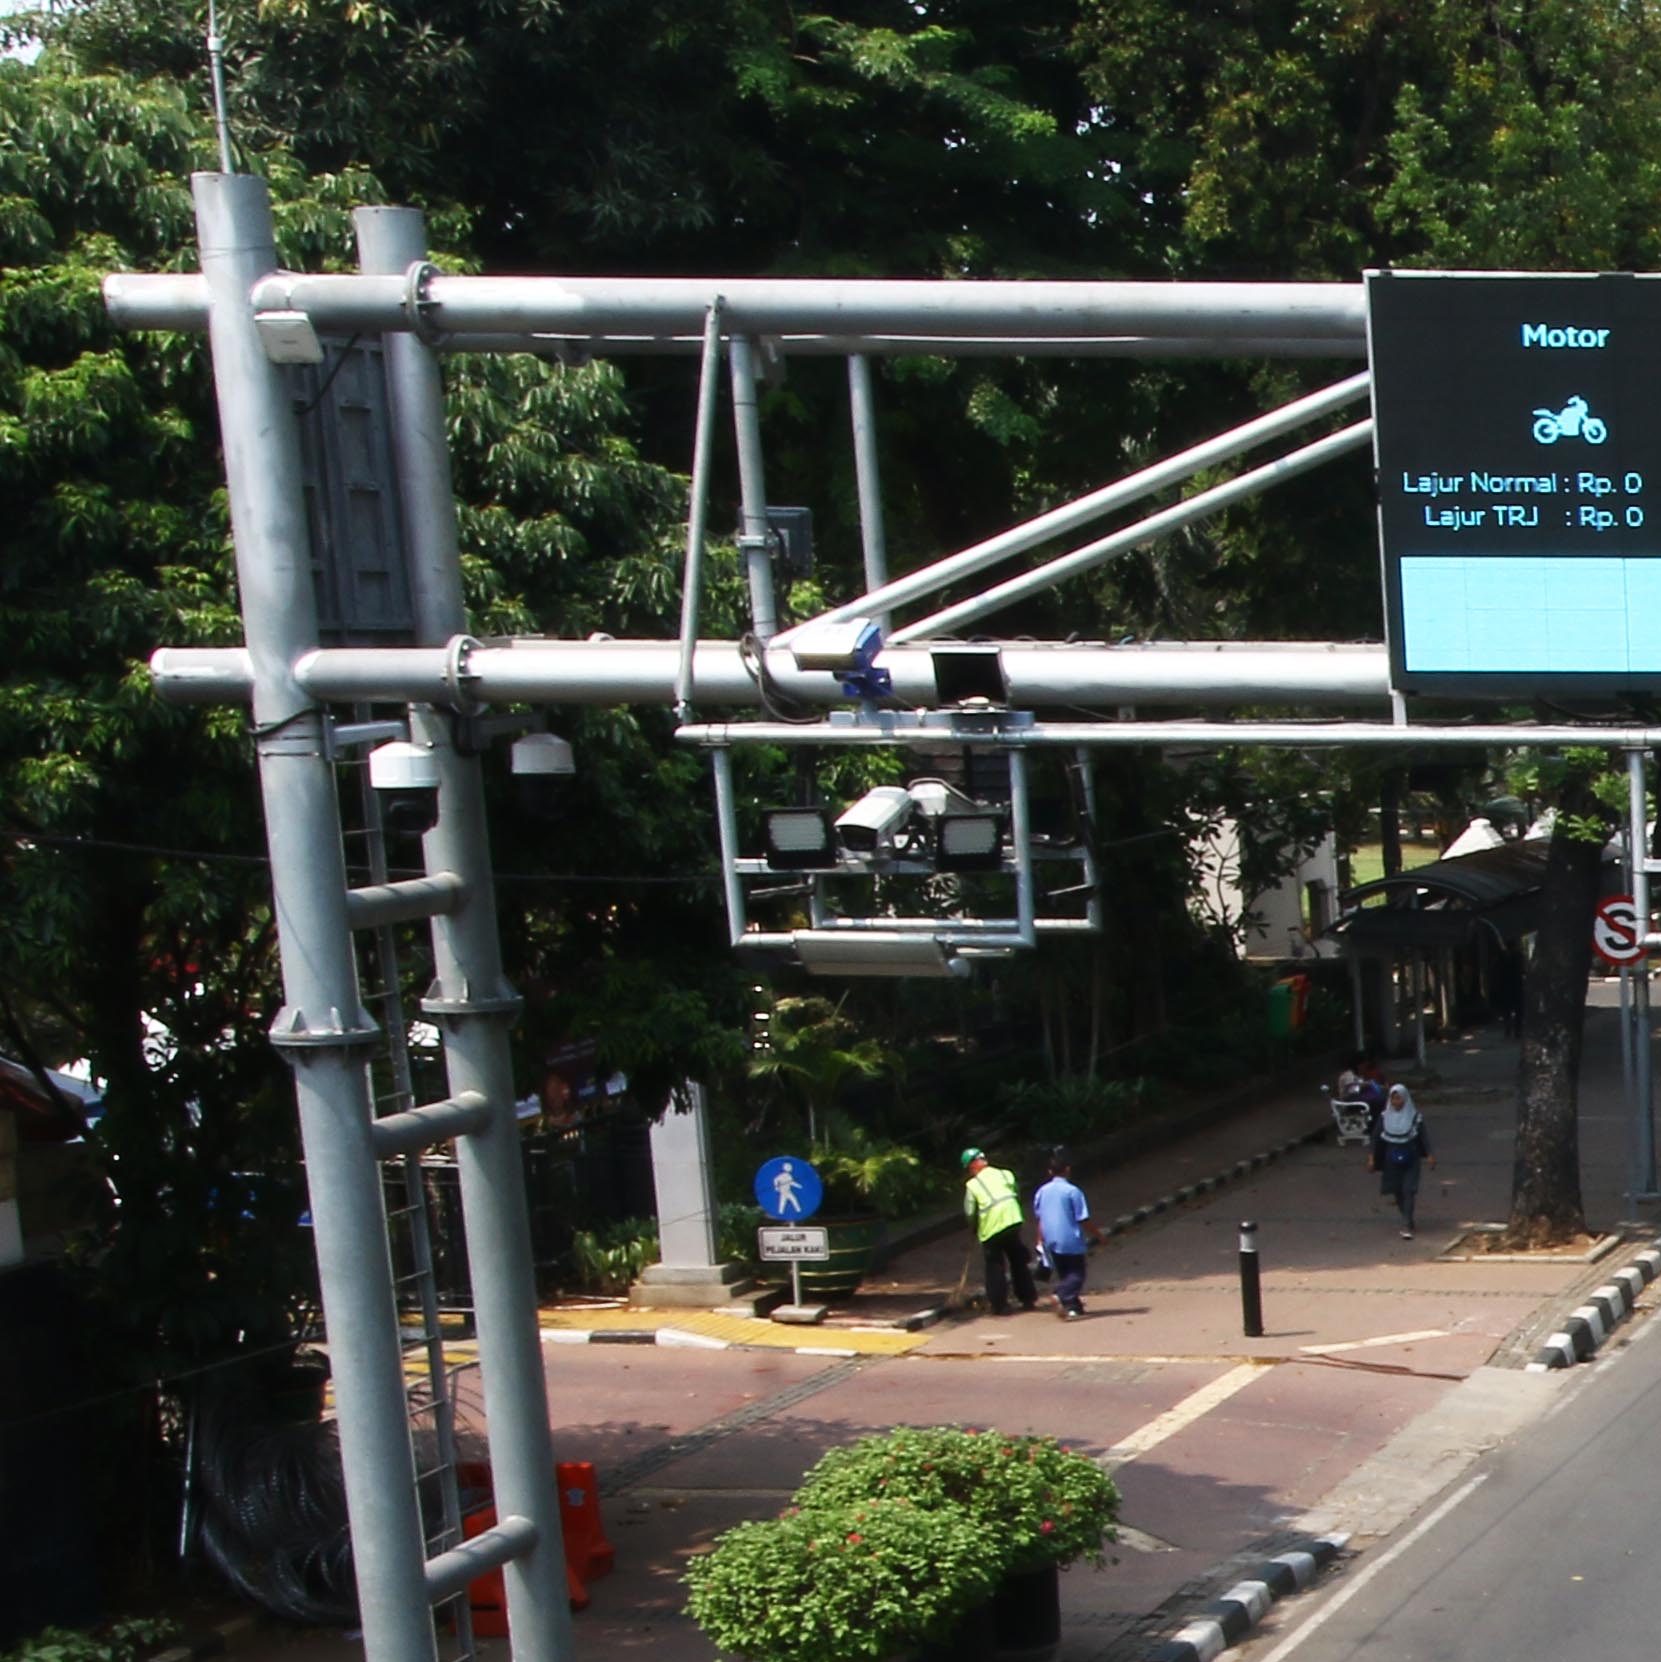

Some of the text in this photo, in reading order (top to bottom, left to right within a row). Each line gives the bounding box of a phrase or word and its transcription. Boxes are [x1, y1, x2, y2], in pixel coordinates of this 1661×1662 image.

[1521, 323, 1611, 348] Motor
[1403, 471, 1464, 497] Lajur
[1470, 471, 1558, 493] Normal
[1577, 472, 1617, 498] Rp.
[1424, 505, 1486, 531] Lajur
[1491, 505, 1539, 527] TRJ
[1578, 505, 1619, 532] Rp.
